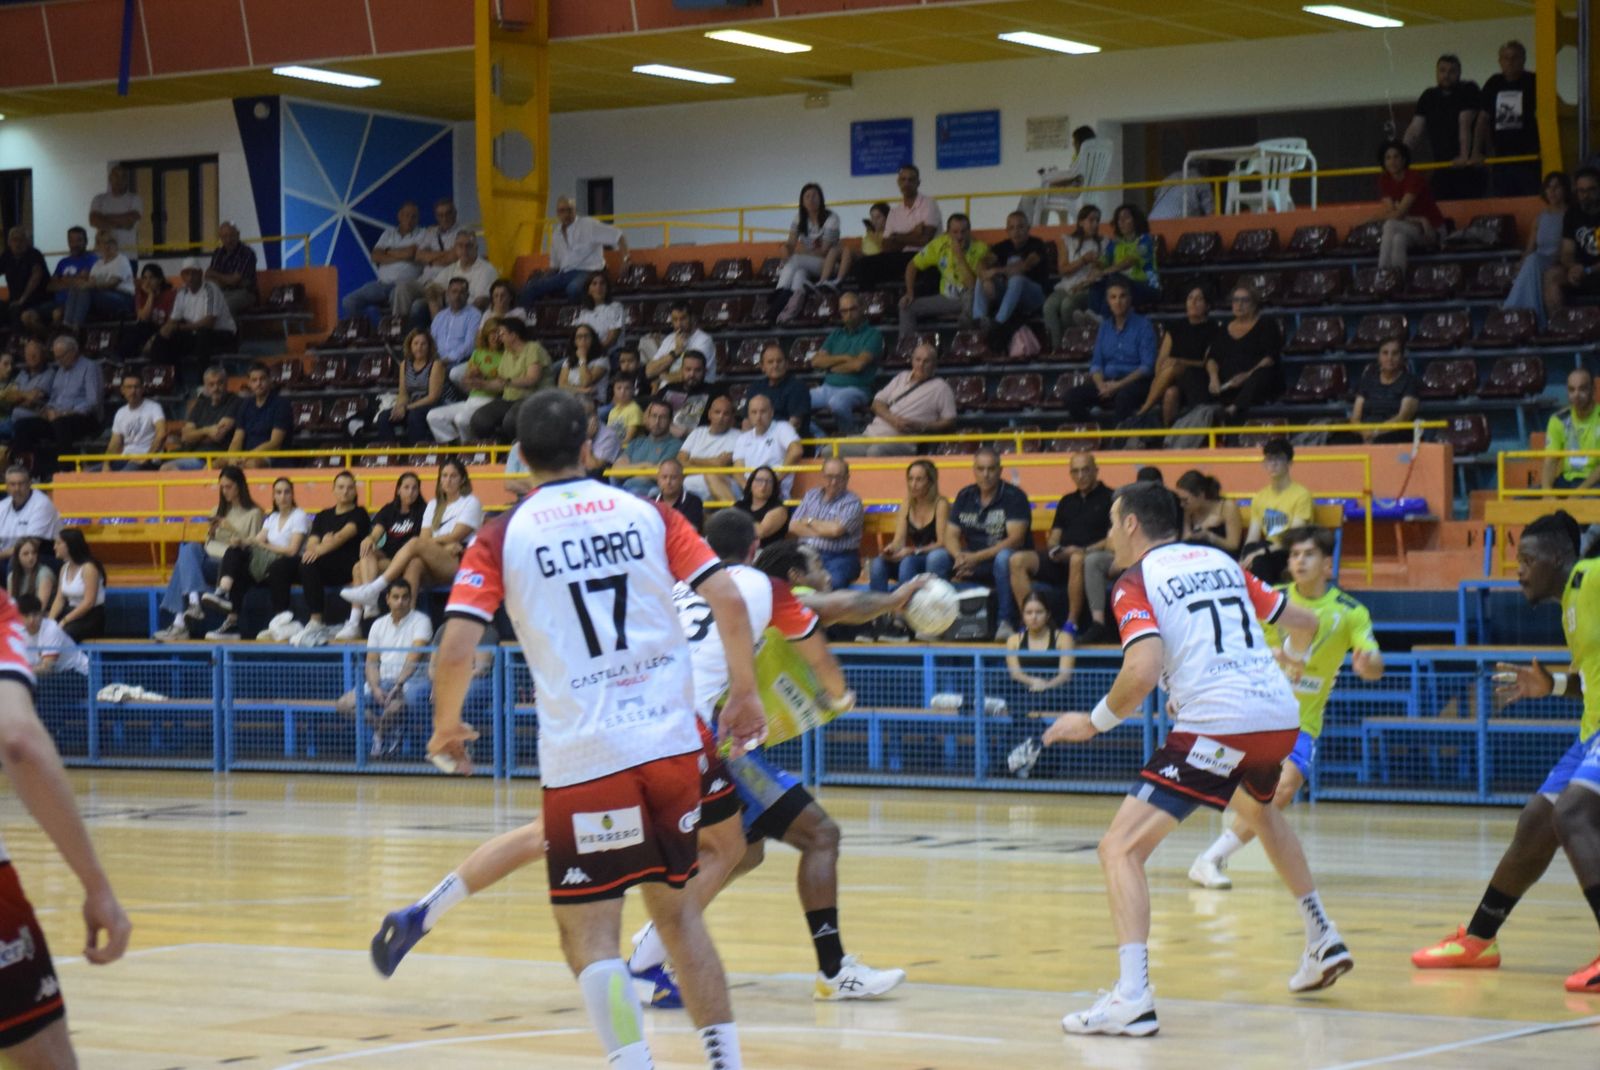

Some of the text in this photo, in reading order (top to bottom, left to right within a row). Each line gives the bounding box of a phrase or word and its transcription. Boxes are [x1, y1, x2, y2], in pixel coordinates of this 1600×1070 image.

[568, 573, 629, 659] 17
[1187, 596, 1254, 654] 77
[579, 828, 640, 844] HERRERO
